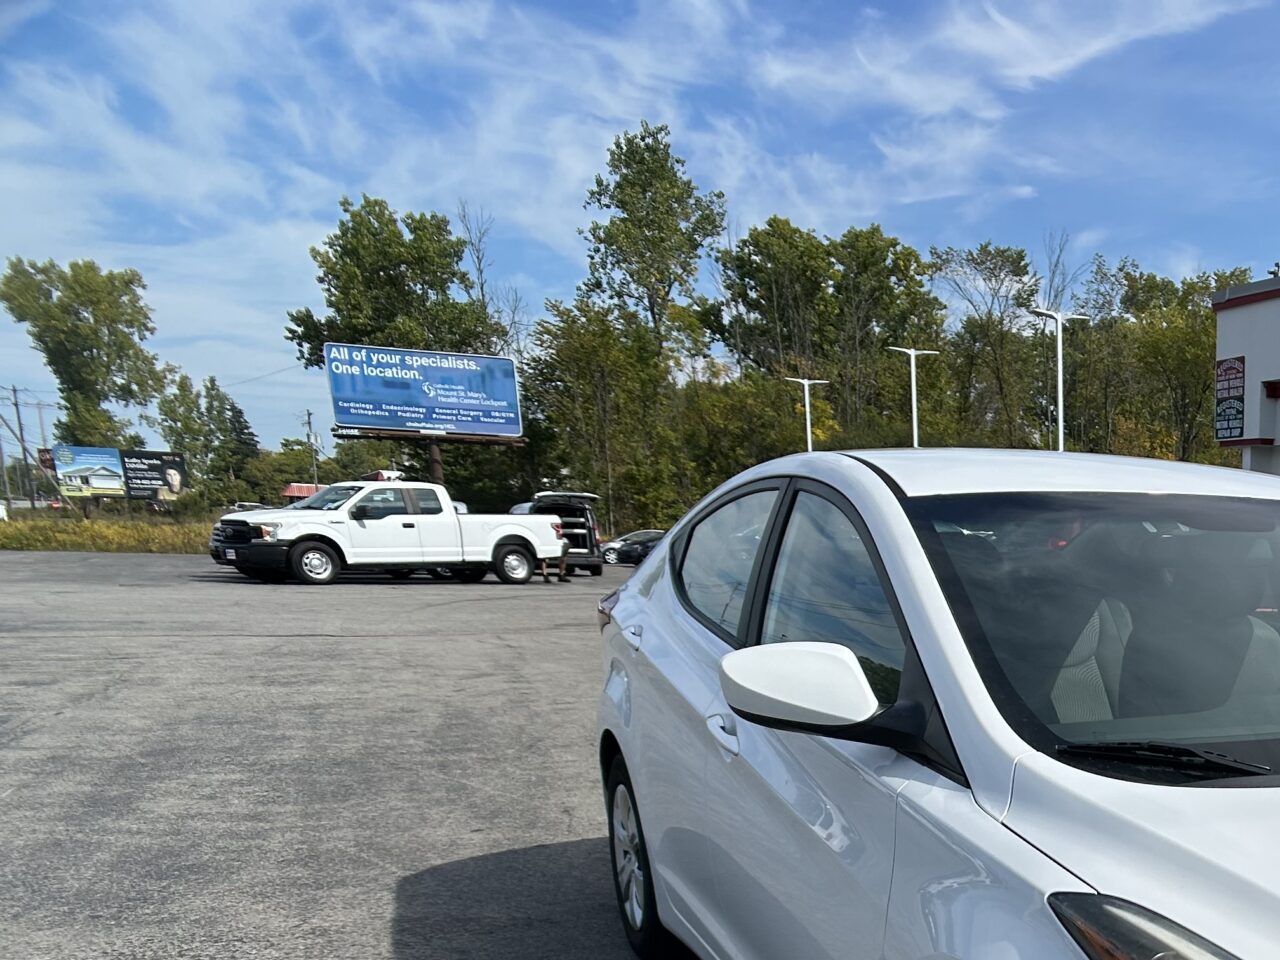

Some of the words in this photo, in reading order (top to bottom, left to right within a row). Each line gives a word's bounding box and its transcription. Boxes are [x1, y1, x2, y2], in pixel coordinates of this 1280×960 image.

[330, 347, 348, 359] All
[352, 349, 367, 361] of
[370, 353, 401, 364] your
[404, 354, 480, 370] specialists.
[332, 361, 360, 374] One
[363, 364, 423, 379] location.
[338, 401, 373, 409] Cardiology
[382, 404, 426, 413] Endocrinology
